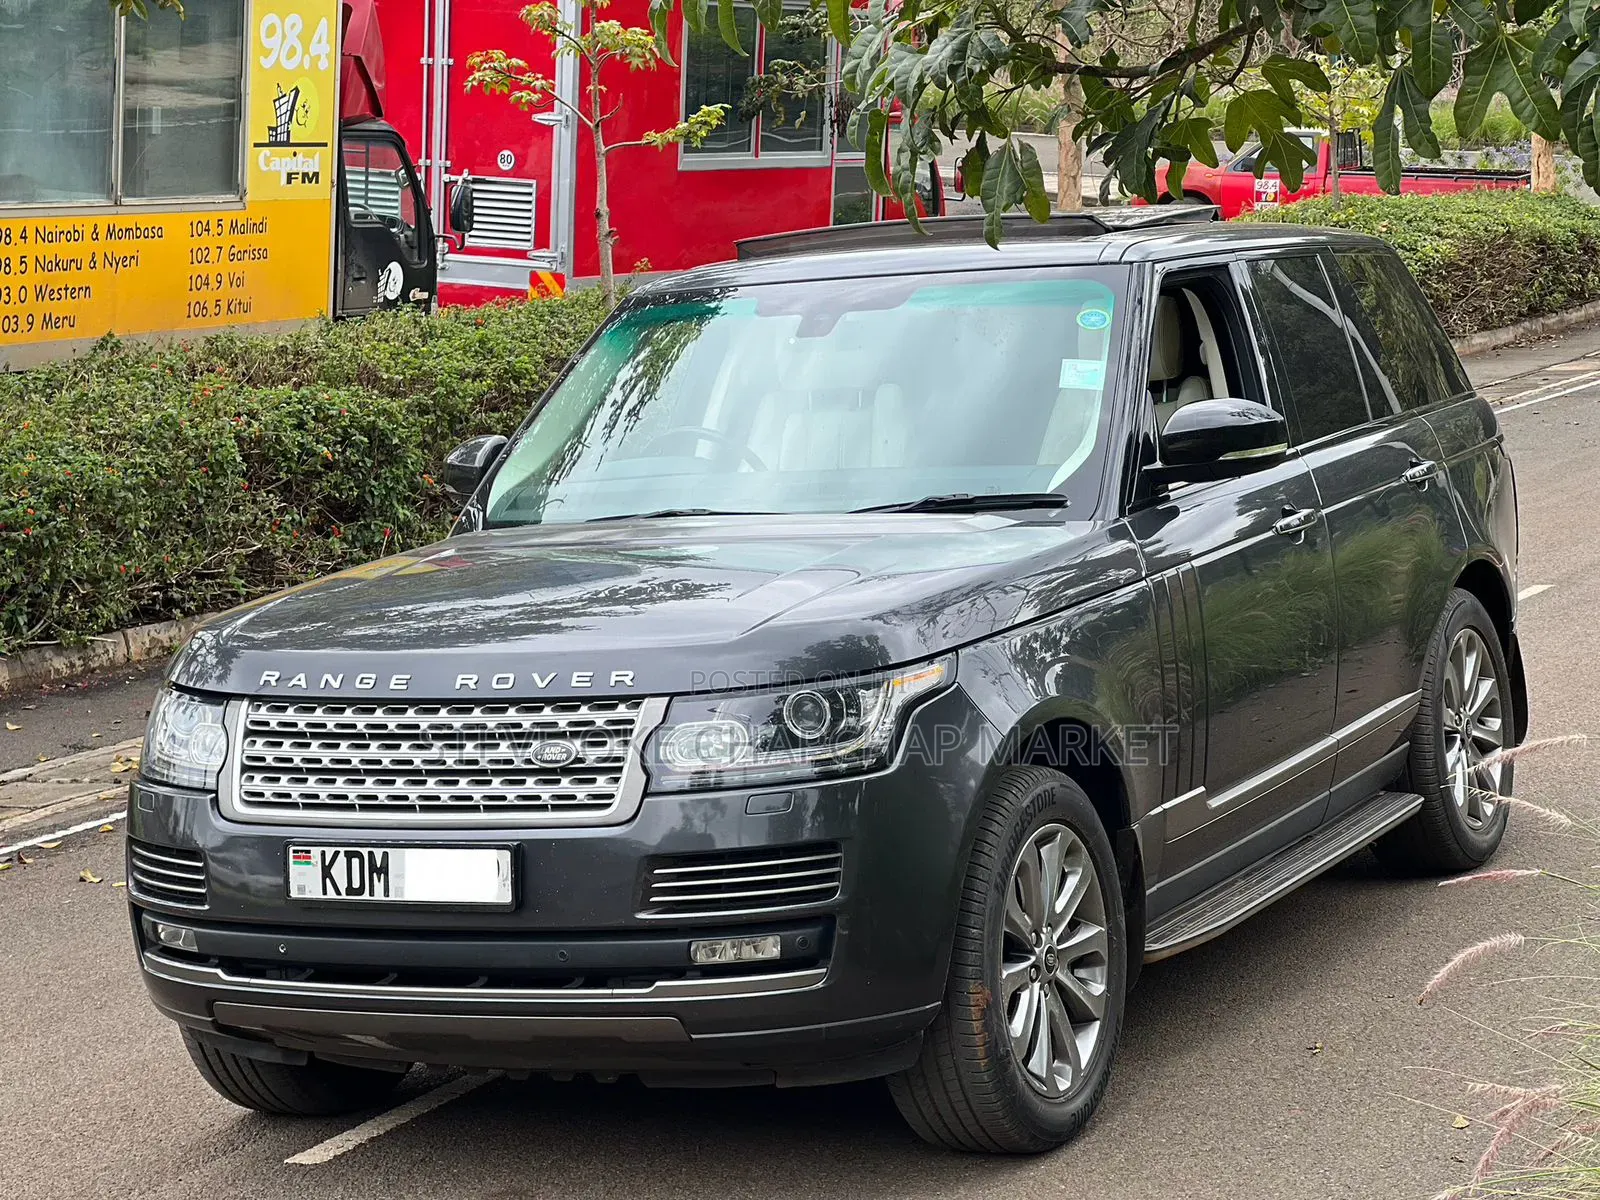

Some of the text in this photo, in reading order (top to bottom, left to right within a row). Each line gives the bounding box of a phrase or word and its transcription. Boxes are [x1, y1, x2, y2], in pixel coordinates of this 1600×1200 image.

[260, 13, 330, 70] 98.4
[258, 150, 320, 187] Capital
[500, 153, 513, 164] 80
[286, 172, 320, 185] FM
[1256, 180, 1278, 190] 98.4
[34, 224, 85, 244] Nairobi
[91, 223, 99, 241] &
[105, 222, 164, 241] Mombasa
[189, 216, 268, 237] 104.5 Malindi
[34, 253, 83, 273] Nakuru
[89, 251, 97, 270] &
[103, 250, 140, 274] Nyeri
[189, 244, 268, 264] 102.7 Garissa
[188, 271, 245, 291] 104.9 Voi
[34, 283, 92, 302] Western
[186, 297, 252, 318] 106.5 Kitui
[41, 312, 76, 331] Meru
[259, 670, 635, 691] RANGE ROVER
[541, 746, 562, 754] LAND
[541, 753, 567, 761] ROVER
[320, 849, 390, 898] KDM
